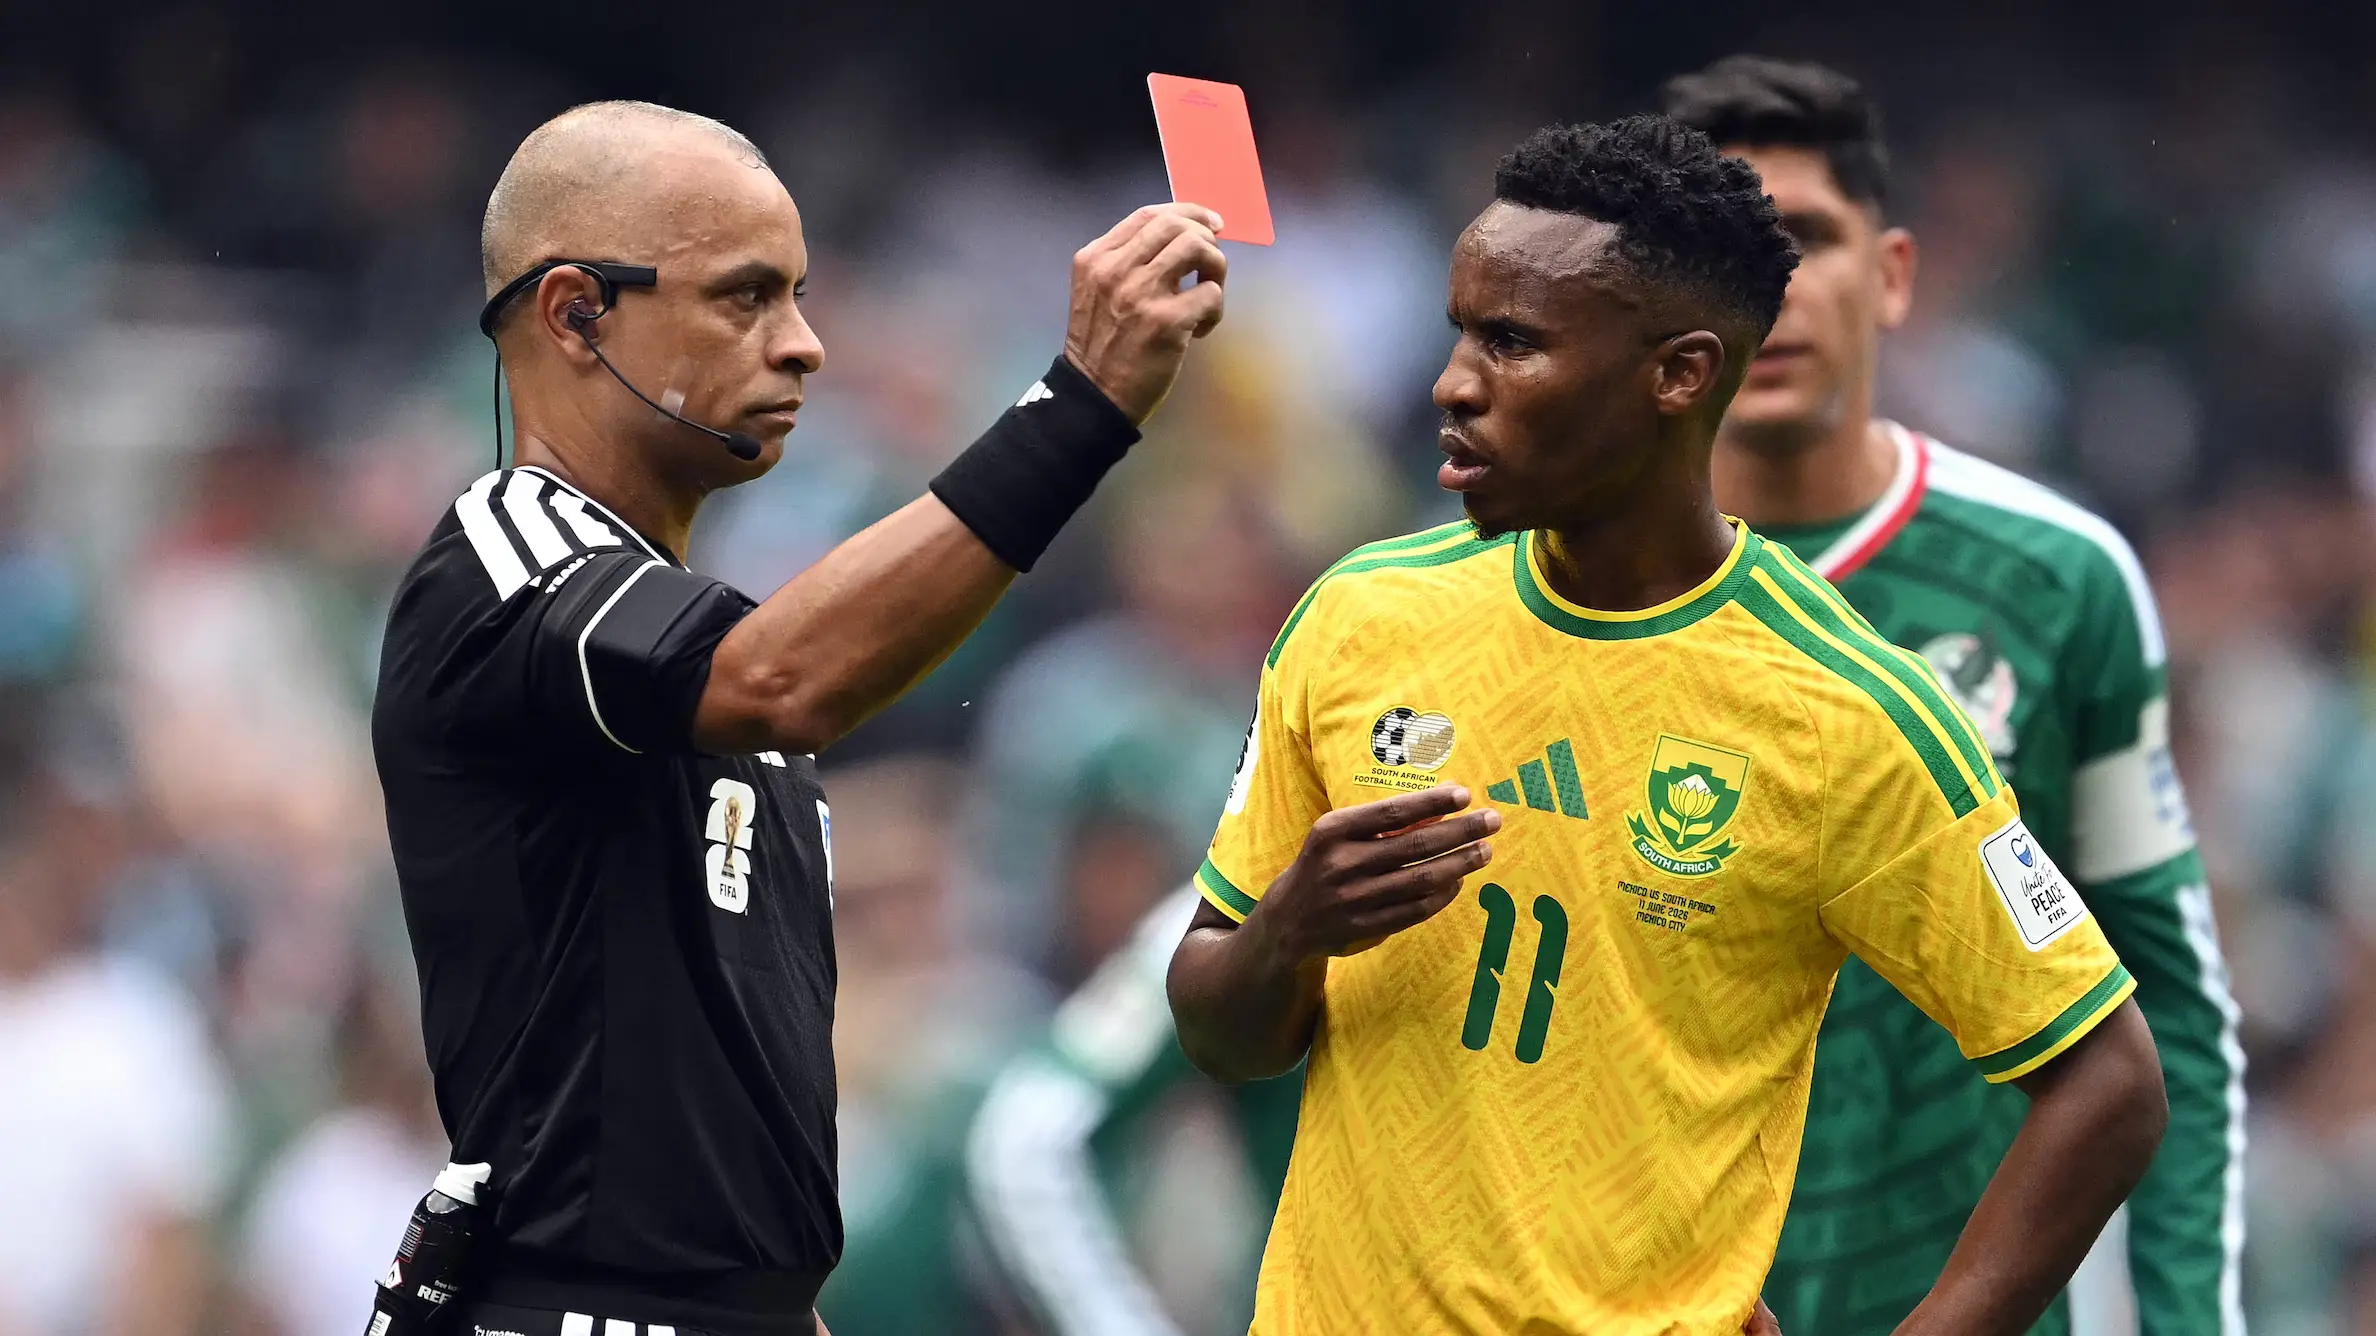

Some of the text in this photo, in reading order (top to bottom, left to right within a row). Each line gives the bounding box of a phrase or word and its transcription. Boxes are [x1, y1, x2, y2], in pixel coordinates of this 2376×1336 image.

[1354, 775, 1435, 790] FOOTBALL ASSOCIA
[1371, 768, 1436, 782] SOUTH AFRICAN
[1638, 842, 1714, 873] SOUTH AFRICA
[720, 883, 737, 900] FIFA
[2020, 871, 2046, 898] Unite
[1617, 880, 1648, 897] MEXICO
[1661, 892, 1687, 907] SOUTH
[1688, 899, 1716, 915] AFRICA
[2031, 882, 2066, 916] PEACE
[1636, 911, 1686, 932] MEXICO CITY
[1646, 901, 1666, 915] JUNE
[1668, 907, 1689, 921] 2026
[2048, 907, 2068, 924] FIFA
[1461, 882, 1569, 1065] 11
